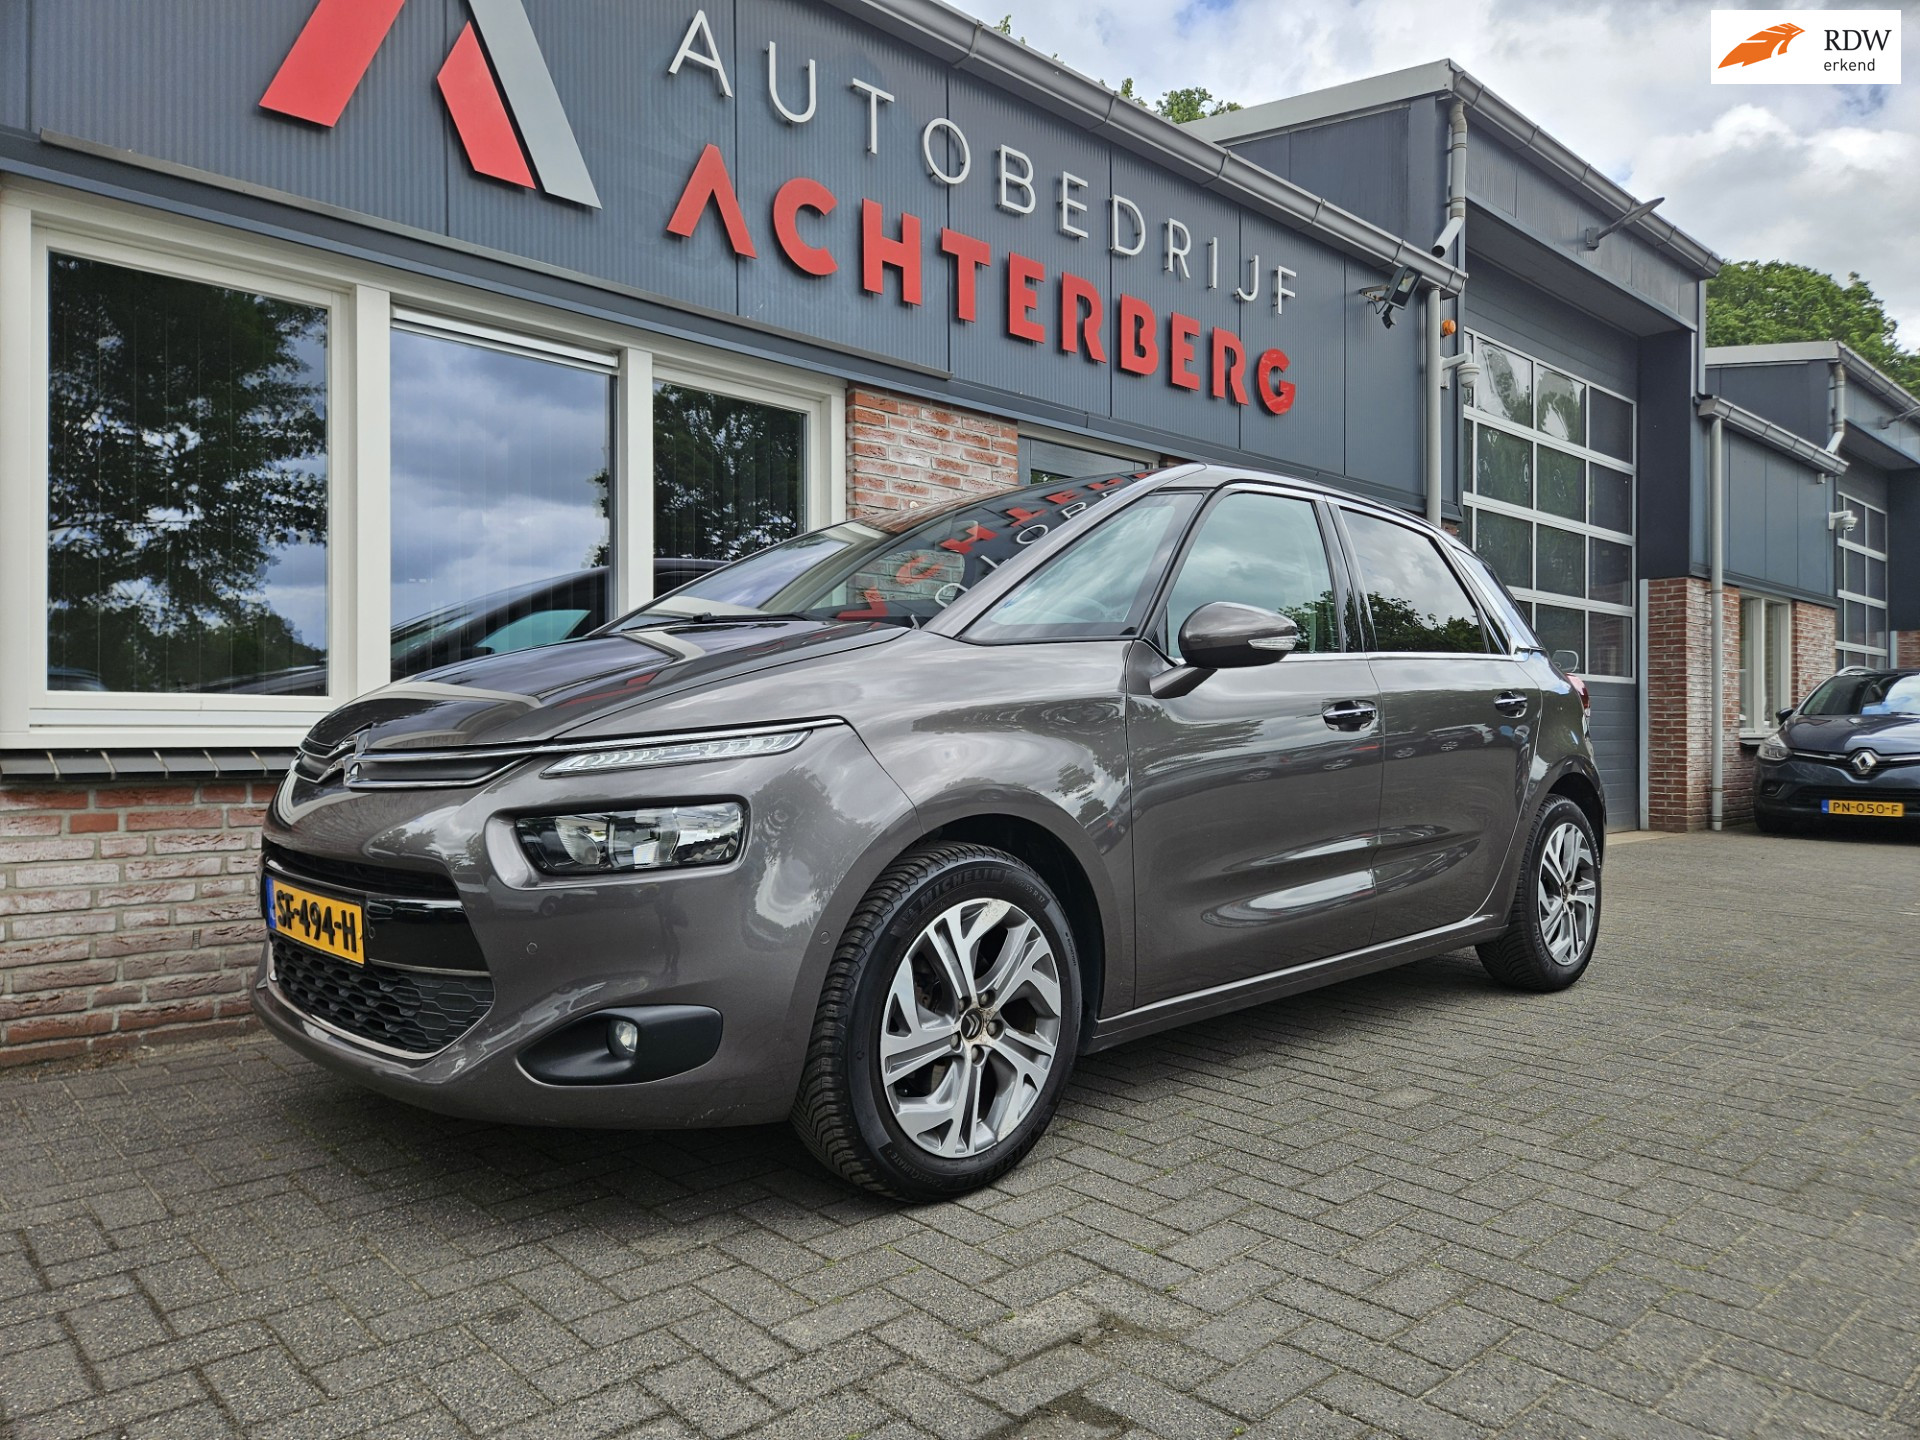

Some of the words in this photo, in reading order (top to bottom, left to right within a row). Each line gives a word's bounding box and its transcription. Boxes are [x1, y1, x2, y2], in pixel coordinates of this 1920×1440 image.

[666, 144, 1296, 415] ACHTERBERG
[668, 10, 1296, 314] AUTOBEDRIJF
[276, 889, 357, 953] SF-494-H
